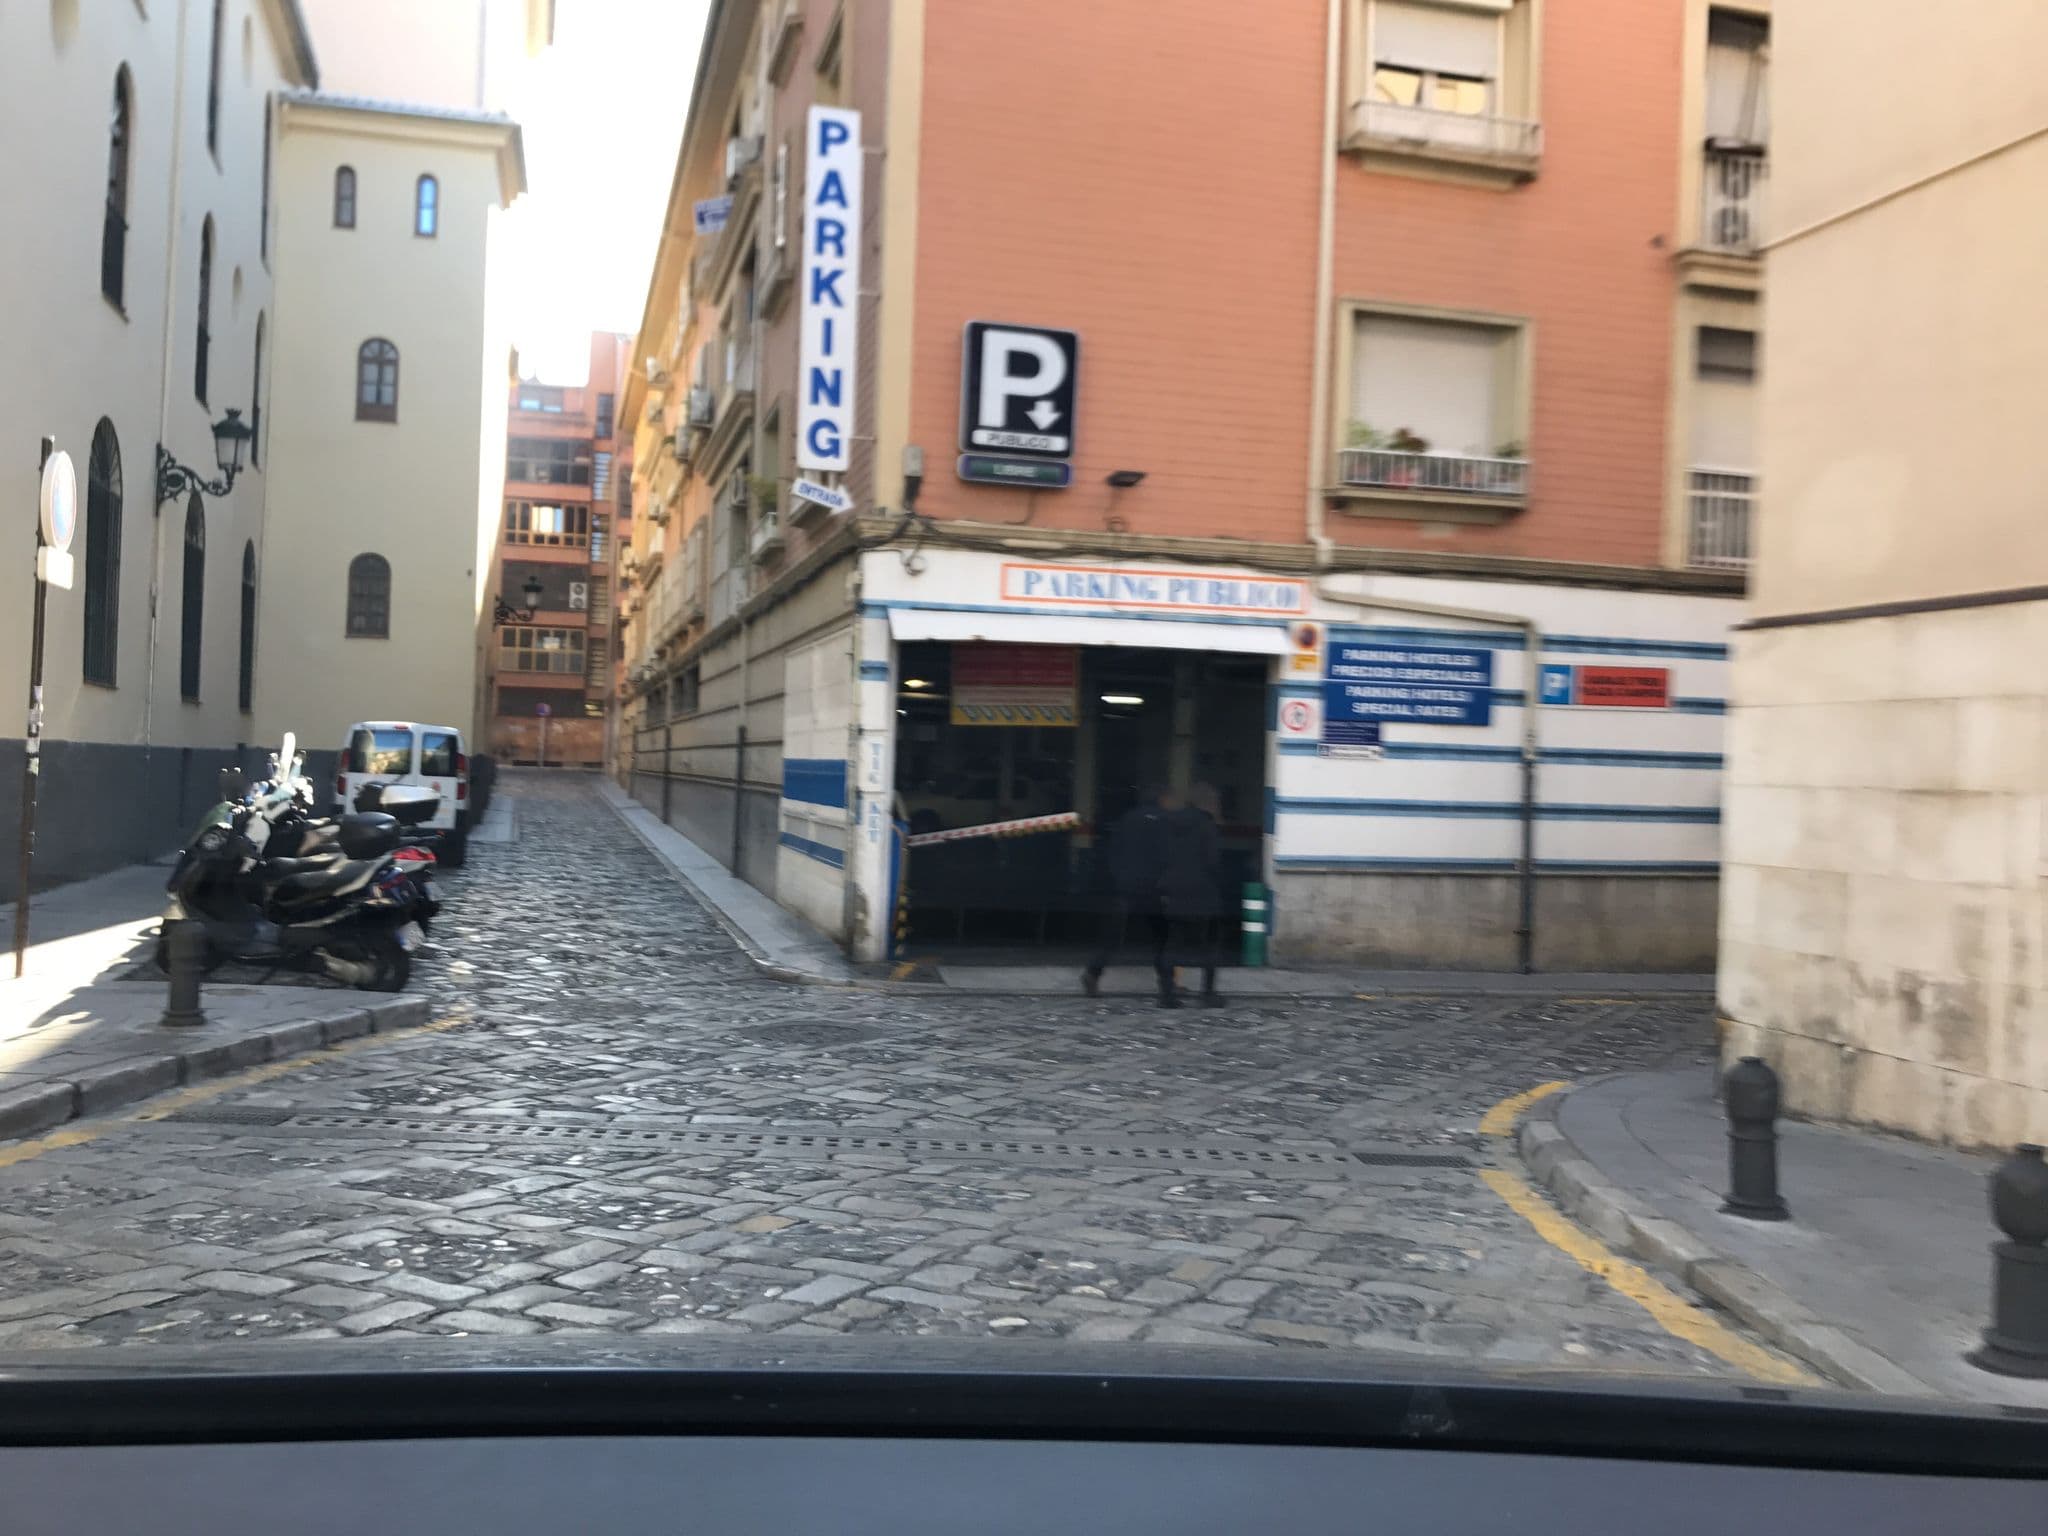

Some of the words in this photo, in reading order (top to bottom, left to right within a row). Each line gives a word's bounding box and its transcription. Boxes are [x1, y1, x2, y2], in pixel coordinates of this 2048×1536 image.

[806, 118, 850, 460] PARKING
[978, 328, 1067, 429] P
[799, 482, 843, 507] ENTRADA
[1023, 569, 1161, 601] PARKING
[1167, 578, 1299, 608] PUBLICO
[1342, 649, 1408, 663] PARKING
[1409, 652, 1480, 666] HOTELES
[1331, 664, 1394, 678] PRECIOS
[1396, 667, 1488, 682] ESPECIALES
[1345, 686, 1410, 699] PARKING
[1411, 689, 1473, 702] HOTELS
[1351, 702, 1413, 716] SPECIAL
